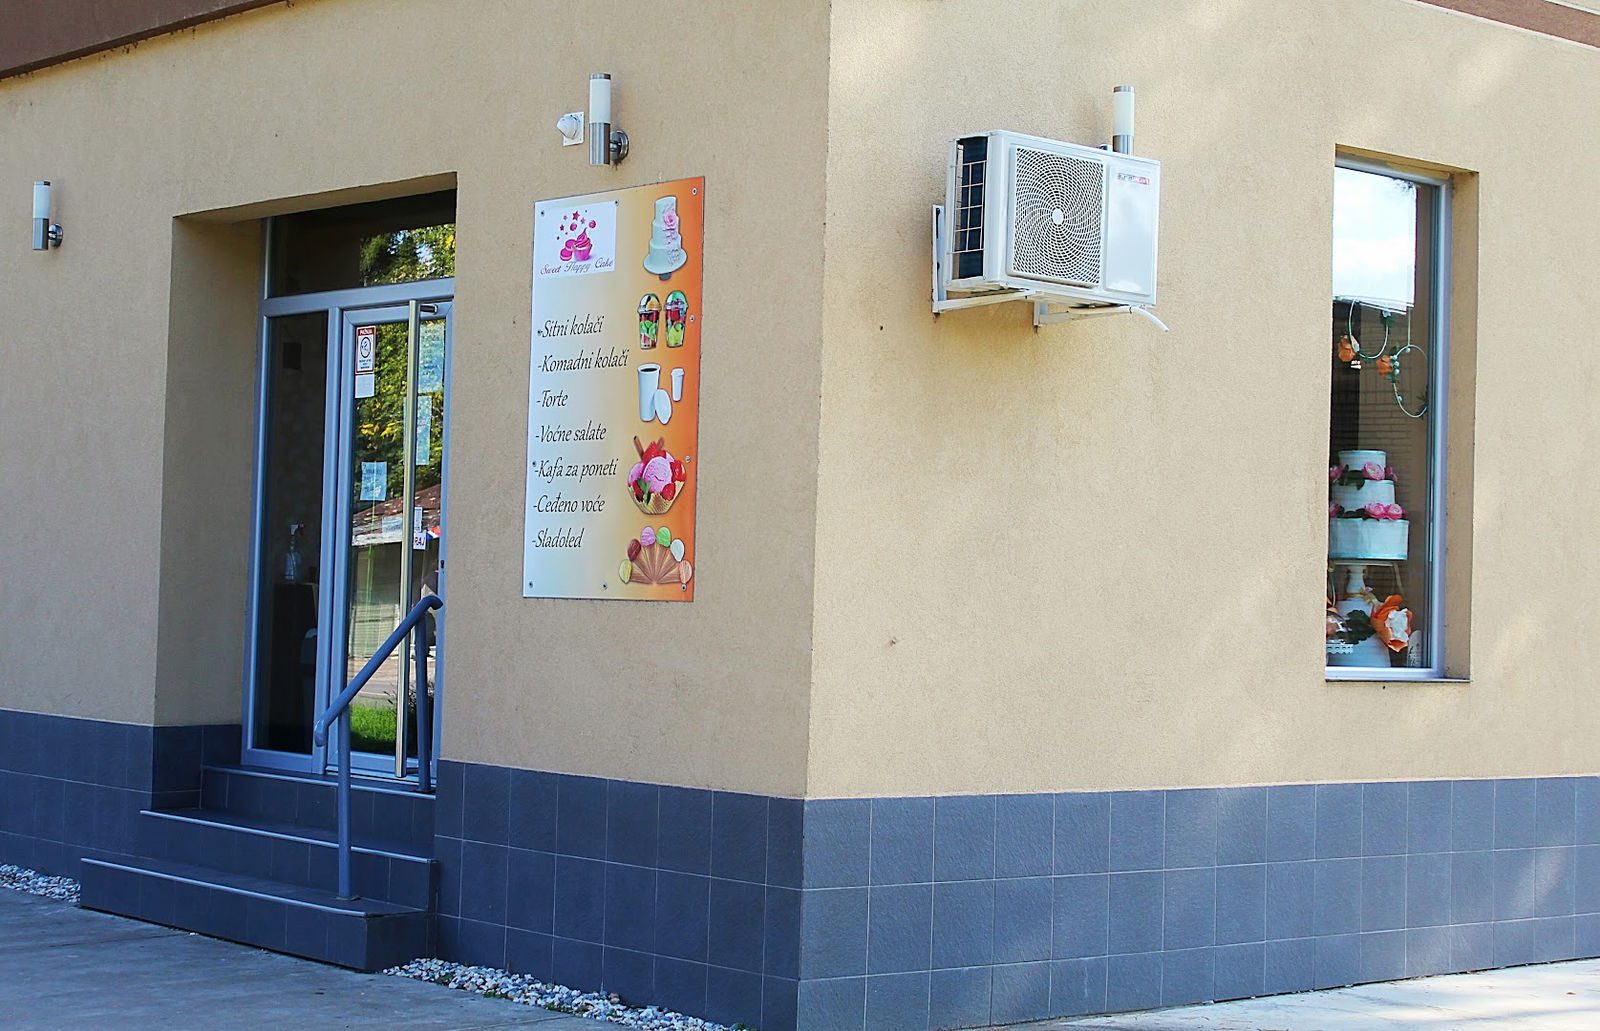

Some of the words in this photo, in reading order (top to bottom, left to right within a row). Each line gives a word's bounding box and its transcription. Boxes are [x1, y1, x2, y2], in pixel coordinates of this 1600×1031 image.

[540, 263, 562, 275] Sweet
[594, 257, 614, 269] Cake
[570, 314, 605, 336] kolači
[537, 349, 593, 373] -Komadni
[594, 347, 630, 369] kolači
[536, 389, 569, 408] -Torte
[535, 424, 573, 443] -Voćne
[573, 421, 607, 441] salate
[534, 456, 564, 484] -Kafa
[564, 464, 579, 477] za
[579, 458, 618, 483] poneti
[532, 492, 578, 513] -Ceđeno
[580, 495, 605, 513] voće
[531, 528, 585, 549] -Sladoled
